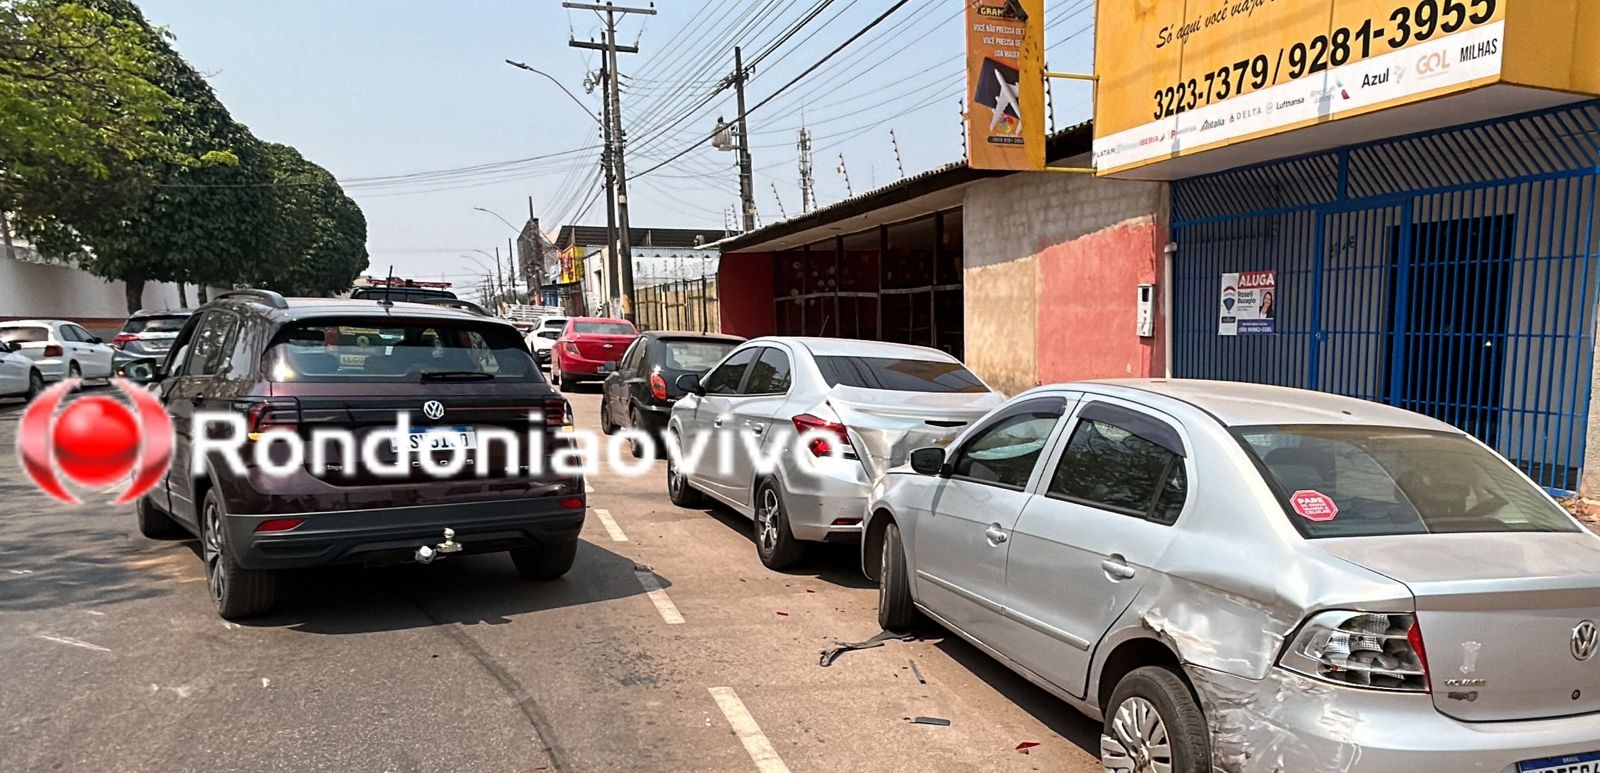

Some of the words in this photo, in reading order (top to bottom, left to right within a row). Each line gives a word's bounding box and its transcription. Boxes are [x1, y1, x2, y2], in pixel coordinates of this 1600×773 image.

[1156, 26, 1173, 48] Só
[1176, 16, 1201, 44] aqui
[1205, 0, 1228, 27] você
[1459, 38, 1498, 63] MILHAS
[1153, 54, 1268, 120] 3223-7379
[1288, 0, 1497, 80] 9281-3955
[1416, 49, 1450, 75] GOL
[1361, 68, 1390, 89] Azul
[1275, 97, 1305, 110] Lufthansa
[1236, 107, 1262, 120] DELTA
[1200, 119, 1225, 132] Alitalia
[1139, 135, 1160, 146] IBERIA
[1097, 147, 1115, 158] LATAM
[1239, 273, 1275, 287] ALUGA
